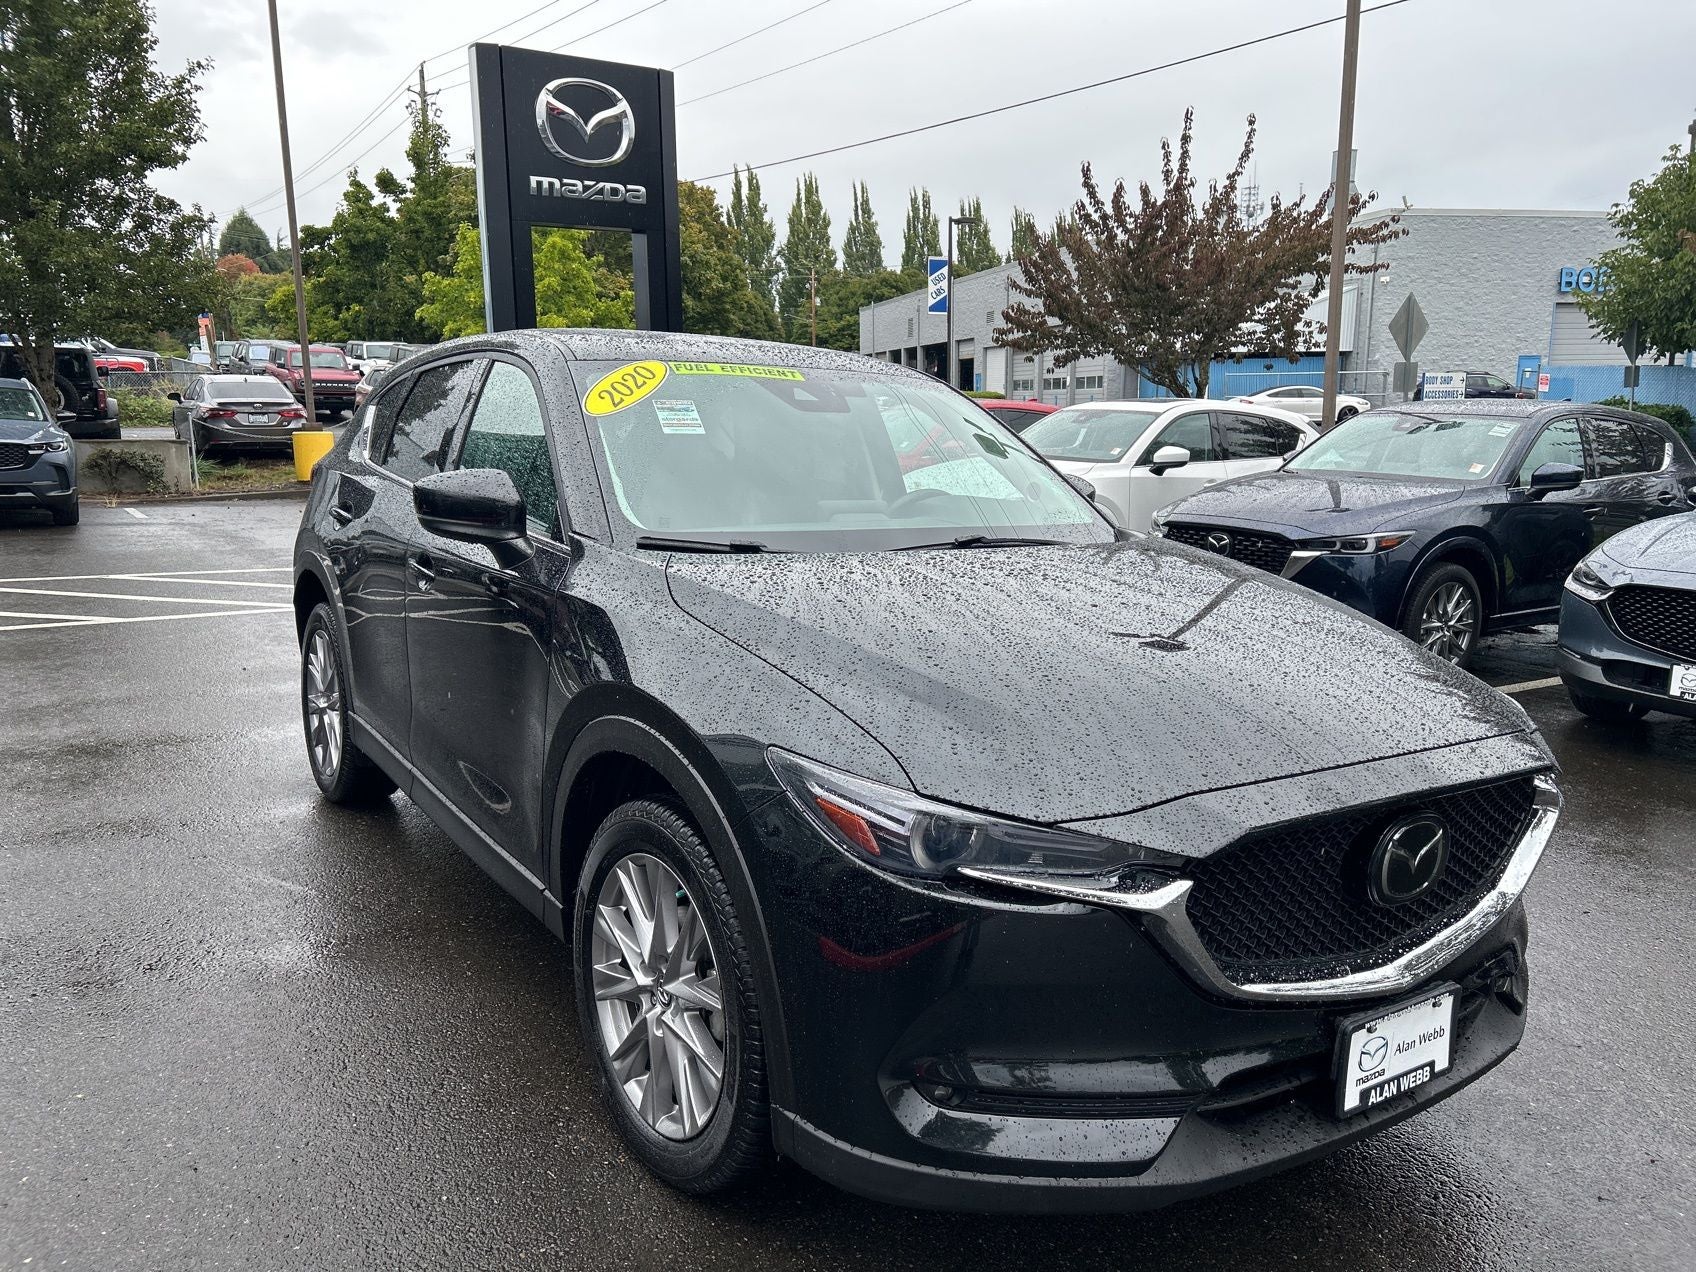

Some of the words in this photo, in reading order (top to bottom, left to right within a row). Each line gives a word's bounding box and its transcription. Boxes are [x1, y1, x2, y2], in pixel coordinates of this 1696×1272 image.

[931, 272, 946, 285] USED
[930, 286, 946, 300] CARS
[674, 363, 715, 373] FUEL
[720, 365, 798, 379] EFFICIENT
[597, 365, 656, 408] 2020
[1425, 375, 1439, 385] BODY
[1440, 375, 1454, 385] SHOP
[1425, 390, 1459, 400] ACCESSORIES
[1394, 1040, 1416, 1056] Alan
[1418, 1026, 1445, 1045] Webb
[1368, 1080, 1398, 1106] ALAN
[1400, 1066, 1431, 1092] WEBB
